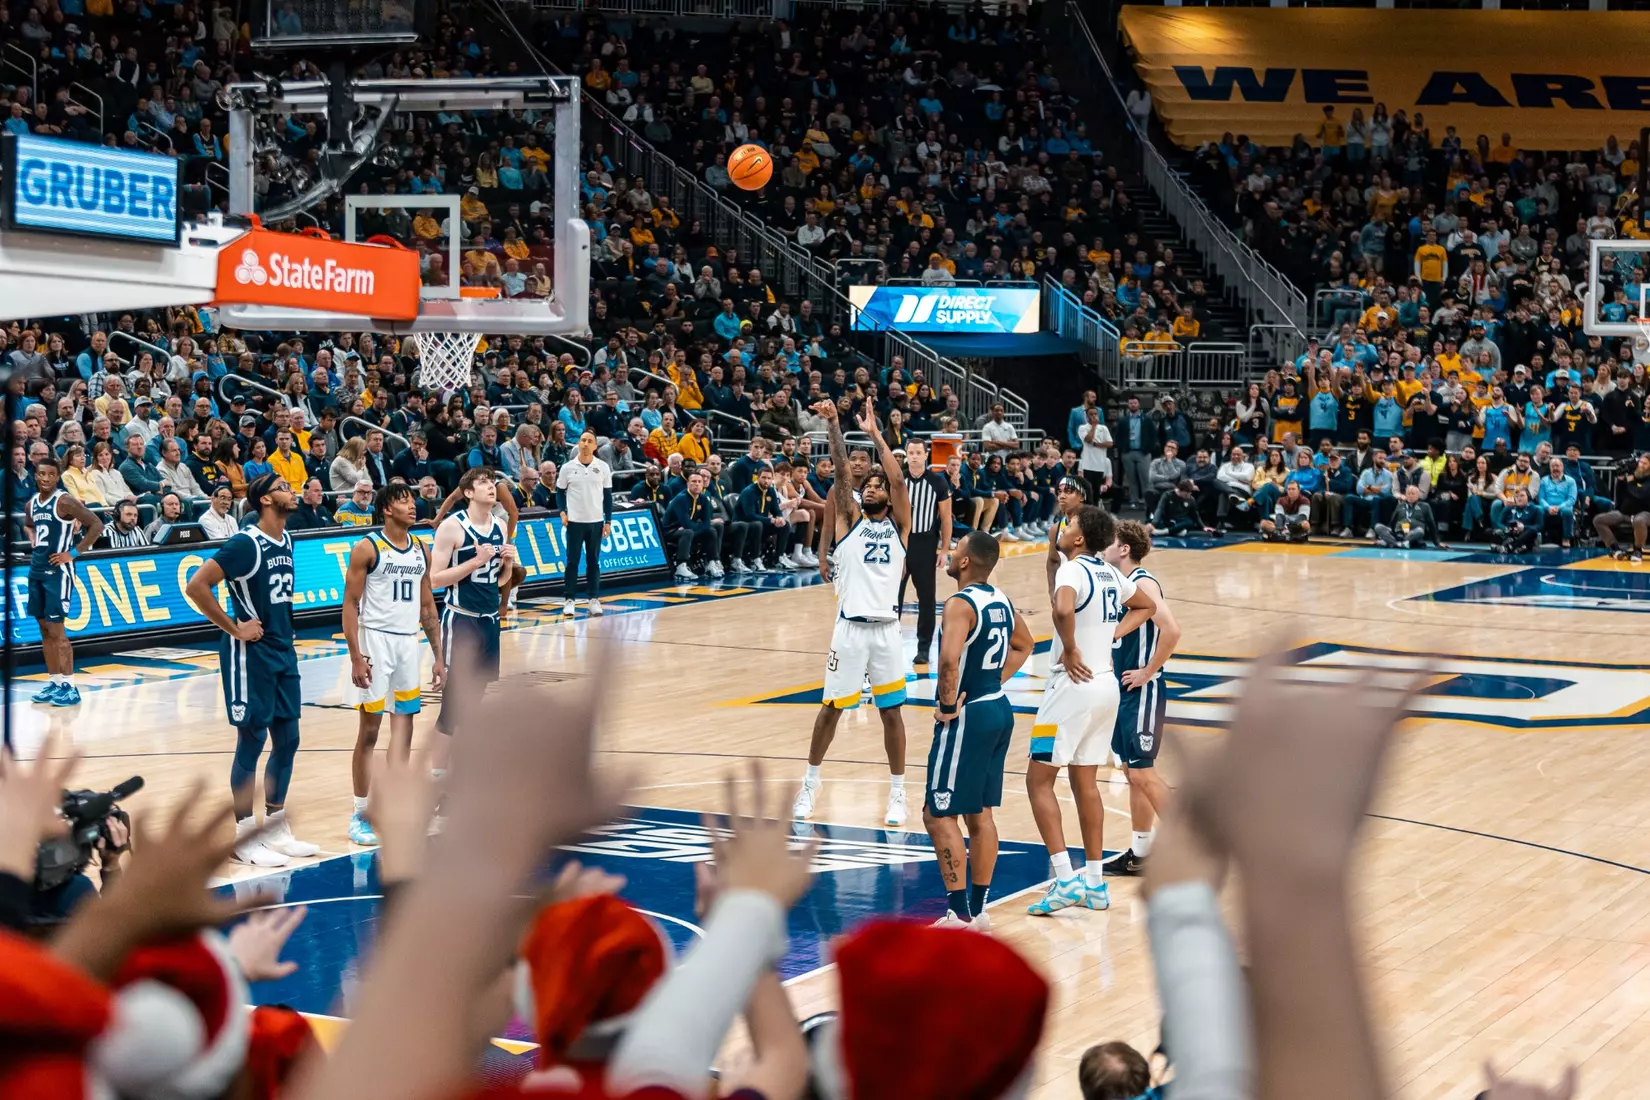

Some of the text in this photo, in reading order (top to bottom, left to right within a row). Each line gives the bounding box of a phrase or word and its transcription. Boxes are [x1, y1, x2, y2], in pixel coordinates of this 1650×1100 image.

[1171, 65, 1650, 111] WE ARE
[20, 158, 174, 220] GRUBER
[938, 295, 996, 310] DIRECT
[936, 310, 992, 325] SUPPLY
[603, 553, 649, 569] OFFICES LLC
[863, 541, 891, 565] 23
[382, 562, 425, 578] Marquette
[269, 573, 293, 604] 23
[393, 578, 413, 602] 10
[1101, 586, 1118, 623] 13
[982, 626, 1008, 670] 21
